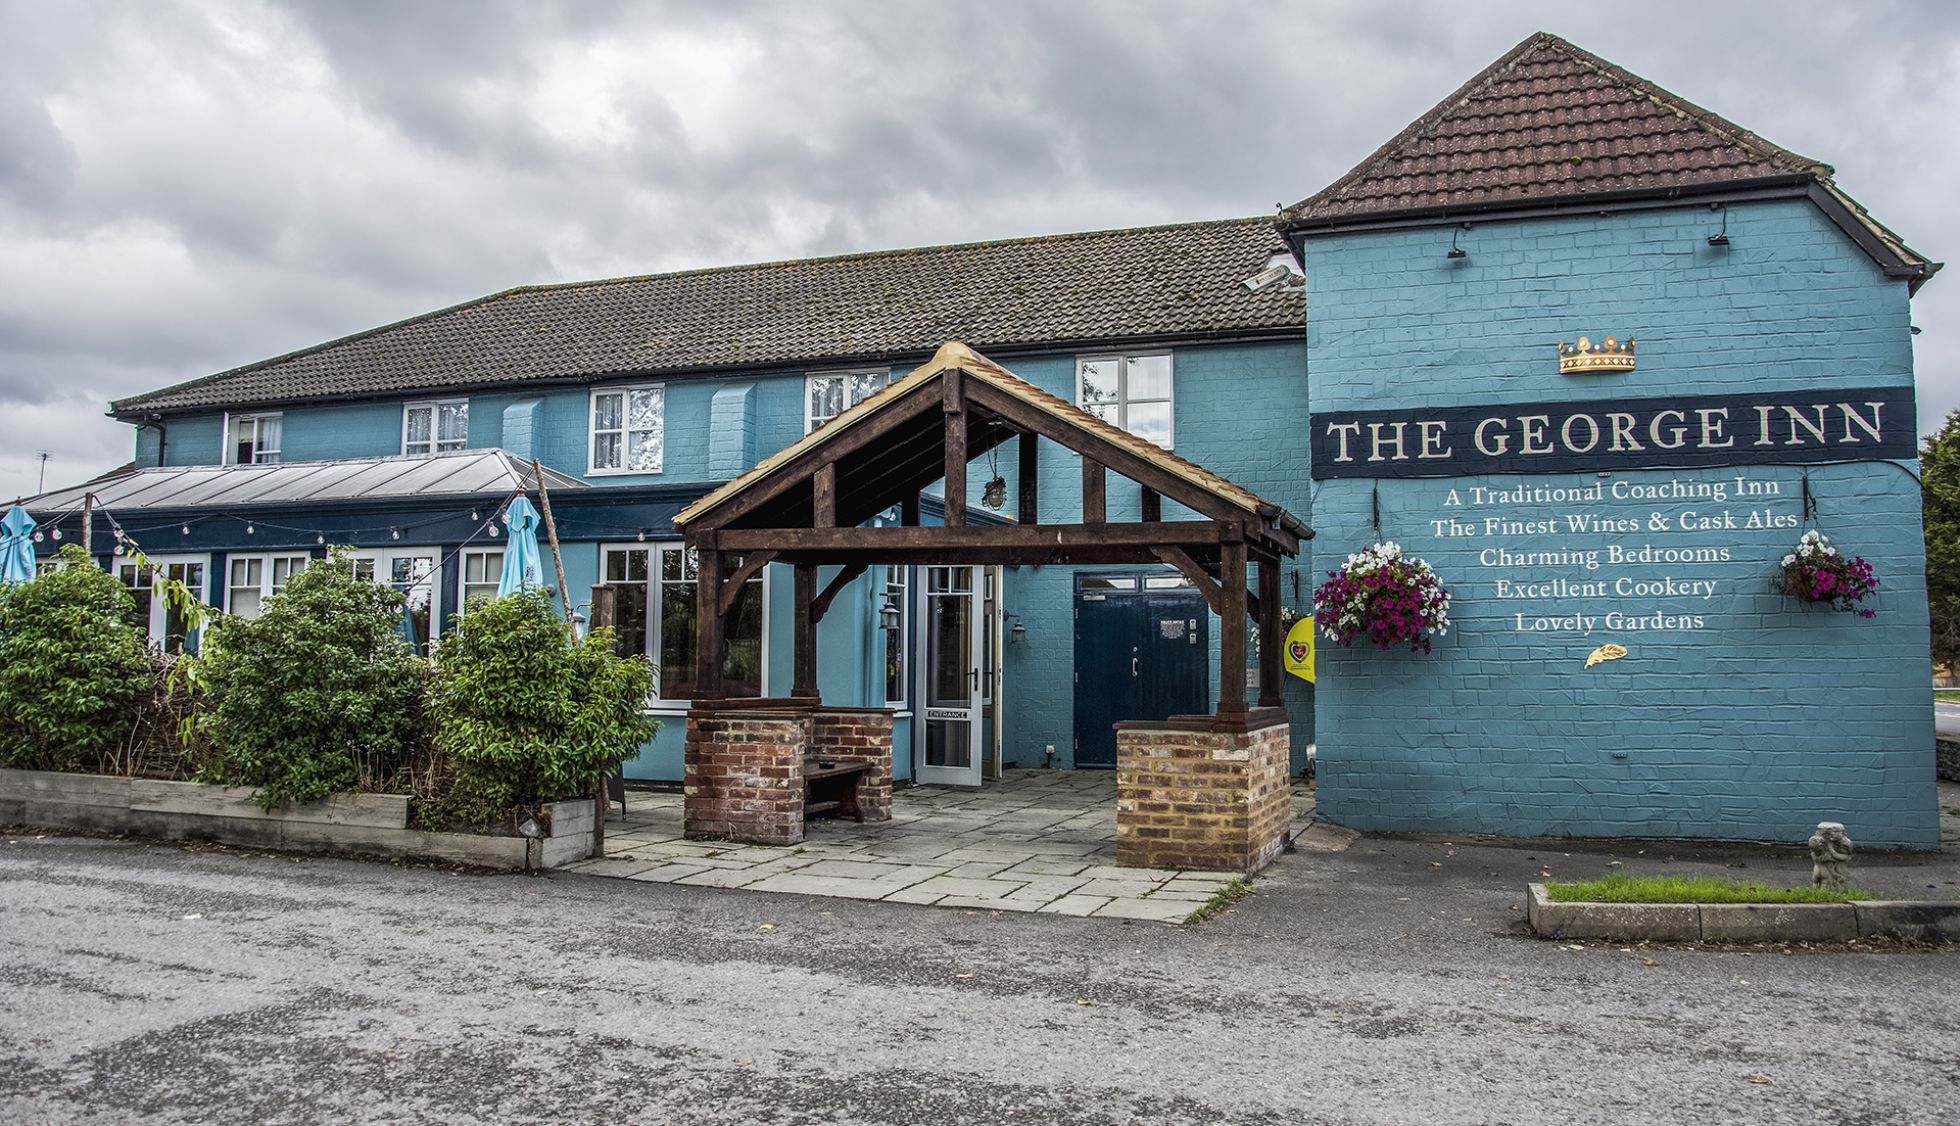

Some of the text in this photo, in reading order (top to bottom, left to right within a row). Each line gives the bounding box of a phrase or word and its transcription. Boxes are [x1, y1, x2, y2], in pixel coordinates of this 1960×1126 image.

[1326, 402, 1885, 462] THE GEORGE INN
[1443, 477, 1780, 506] A Traditional Coaching Inn
[1430, 508, 1798, 538] The Finest Wines & Cask Ales
[1479, 543, 1731, 570] Charming Bedrooms
[1494, 576, 1717, 600] Excellent Cookery
[1514, 610, 1704, 636] Lovely Gardens
